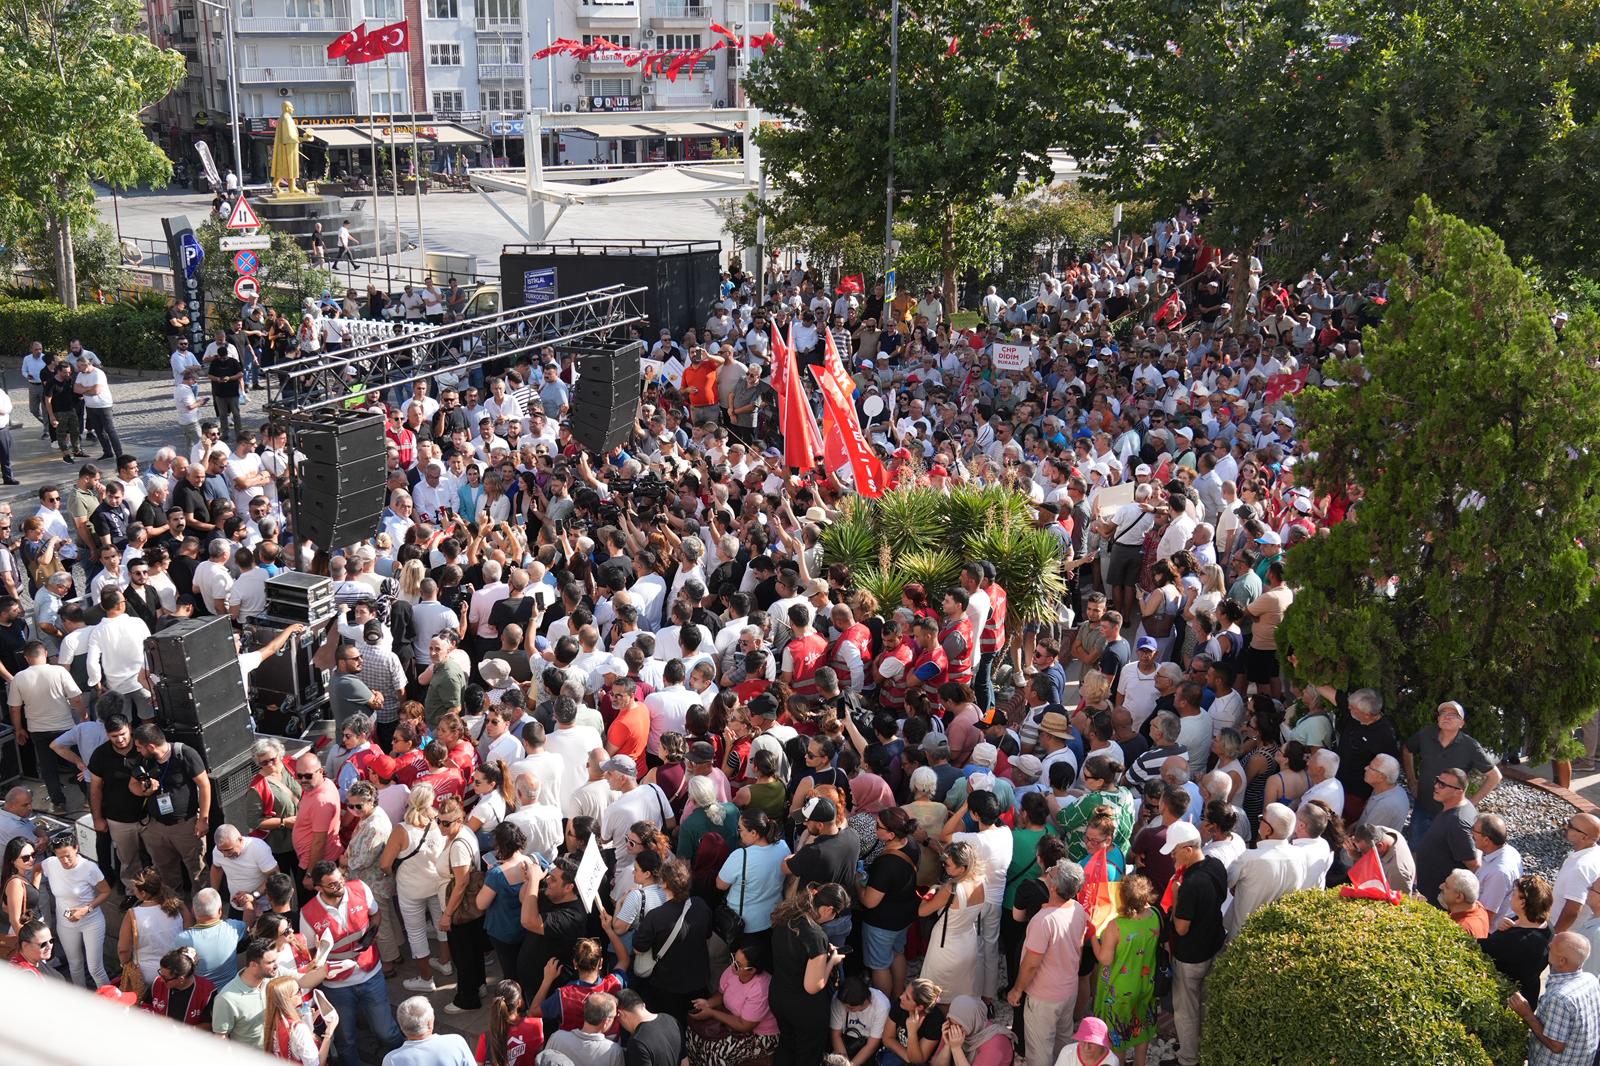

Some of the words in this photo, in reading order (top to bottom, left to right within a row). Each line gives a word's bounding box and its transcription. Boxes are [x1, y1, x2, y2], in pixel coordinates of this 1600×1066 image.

[605, 97, 629, 107] ONUR
[185, 246, 197, 265] P
[186, 278, 204, 354] OTOPARK
[998, 352, 1020, 360] DİDİM
[512, 1045, 525, 1058] CHP
